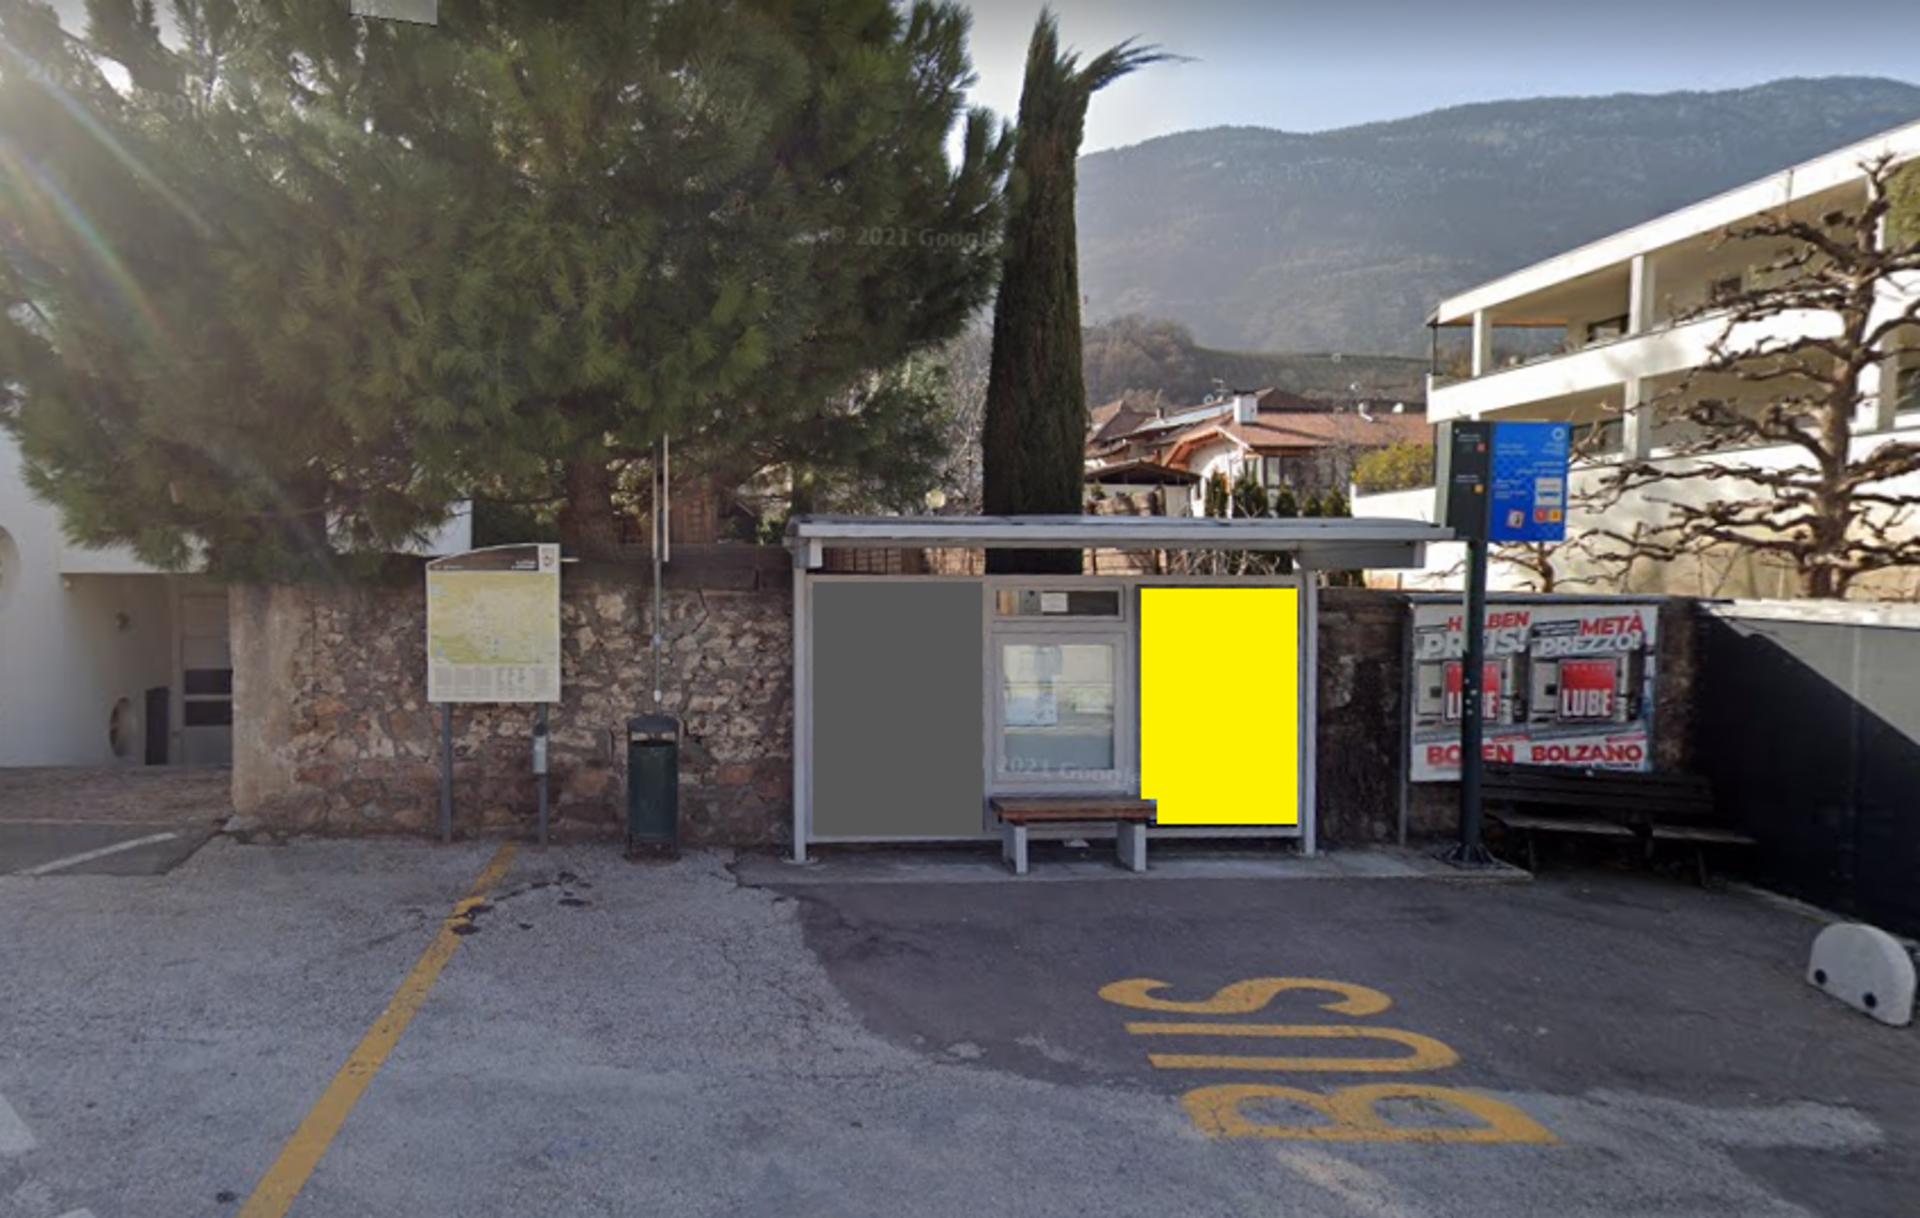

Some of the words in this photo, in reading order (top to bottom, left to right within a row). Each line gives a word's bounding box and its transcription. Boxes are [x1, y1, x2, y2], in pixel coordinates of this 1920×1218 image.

[1446, 611, 1531, 632] HBEN
[1581, 608, 1643, 636] METÀ
[1538, 631, 1641, 656] PREZZO!
[1562, 690, 1612, 717] LUBE
[1427, 744, 1515, 766] BOEN
[1531, 744, 1642, 763] BOLZANO
[1097, 977, 1560, 1144] BUS
